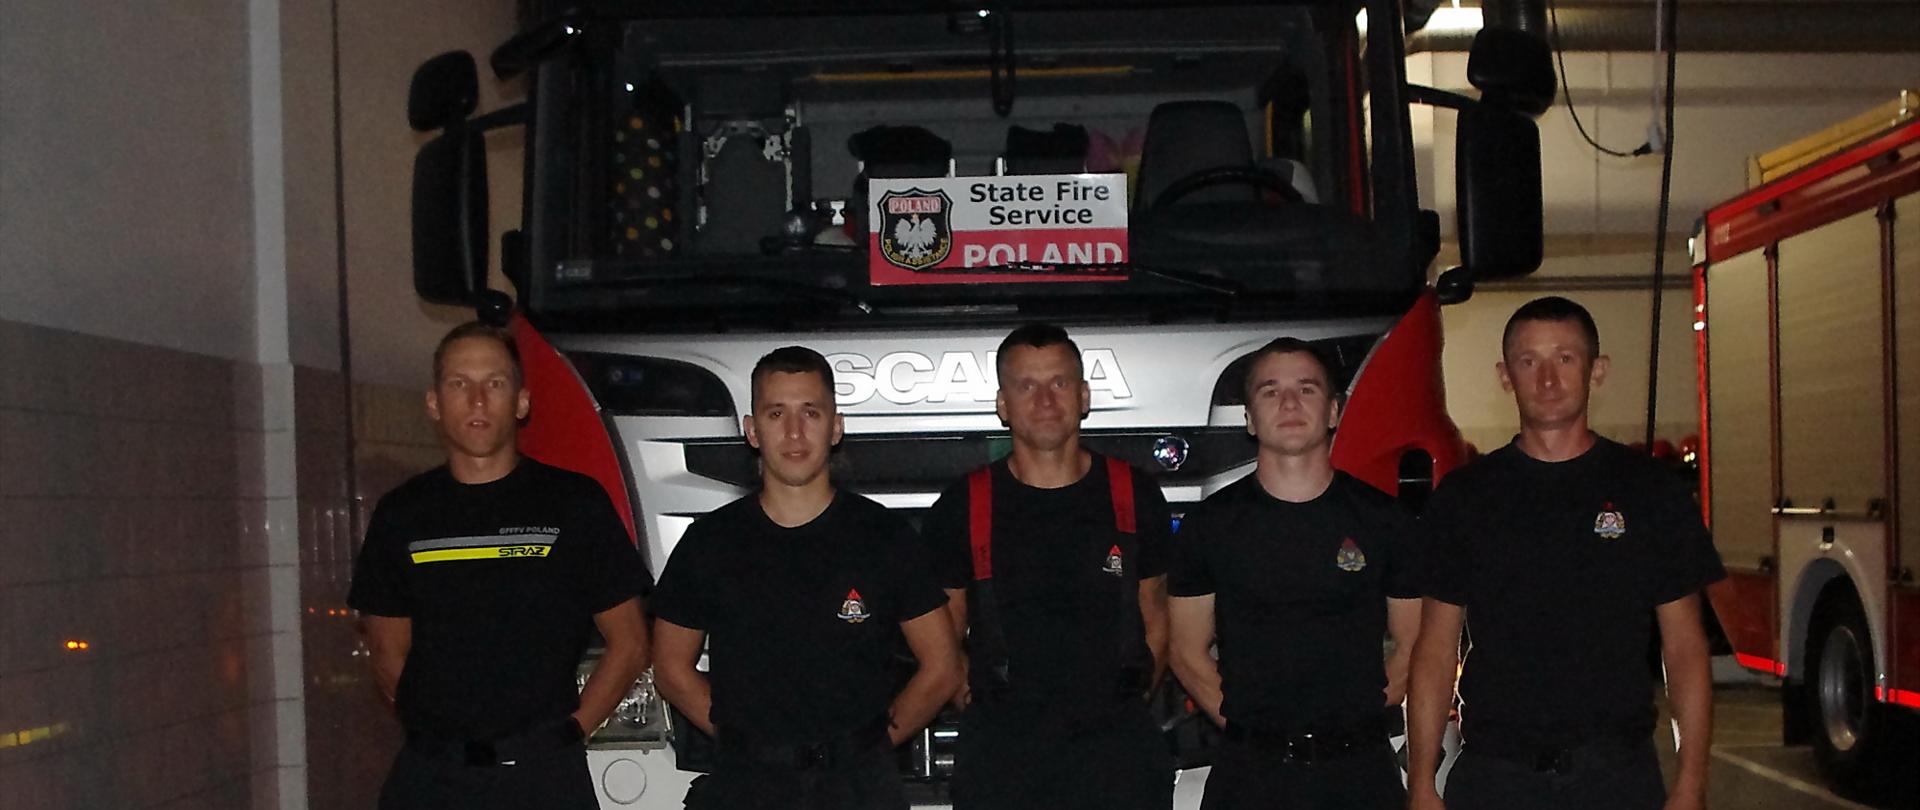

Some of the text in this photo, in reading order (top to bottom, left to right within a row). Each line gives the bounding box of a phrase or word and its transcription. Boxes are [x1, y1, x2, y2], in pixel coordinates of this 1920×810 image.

[970, 181, 1110, 202] State Fire
[891, 198, 940, 212] POLAND
[989, 205, 1093, 225] Service
[965, 243, 1122, 268] POLAND
[825, 349, 1132, 407] SCAA
[526, 527, 560, 535] POLAND
